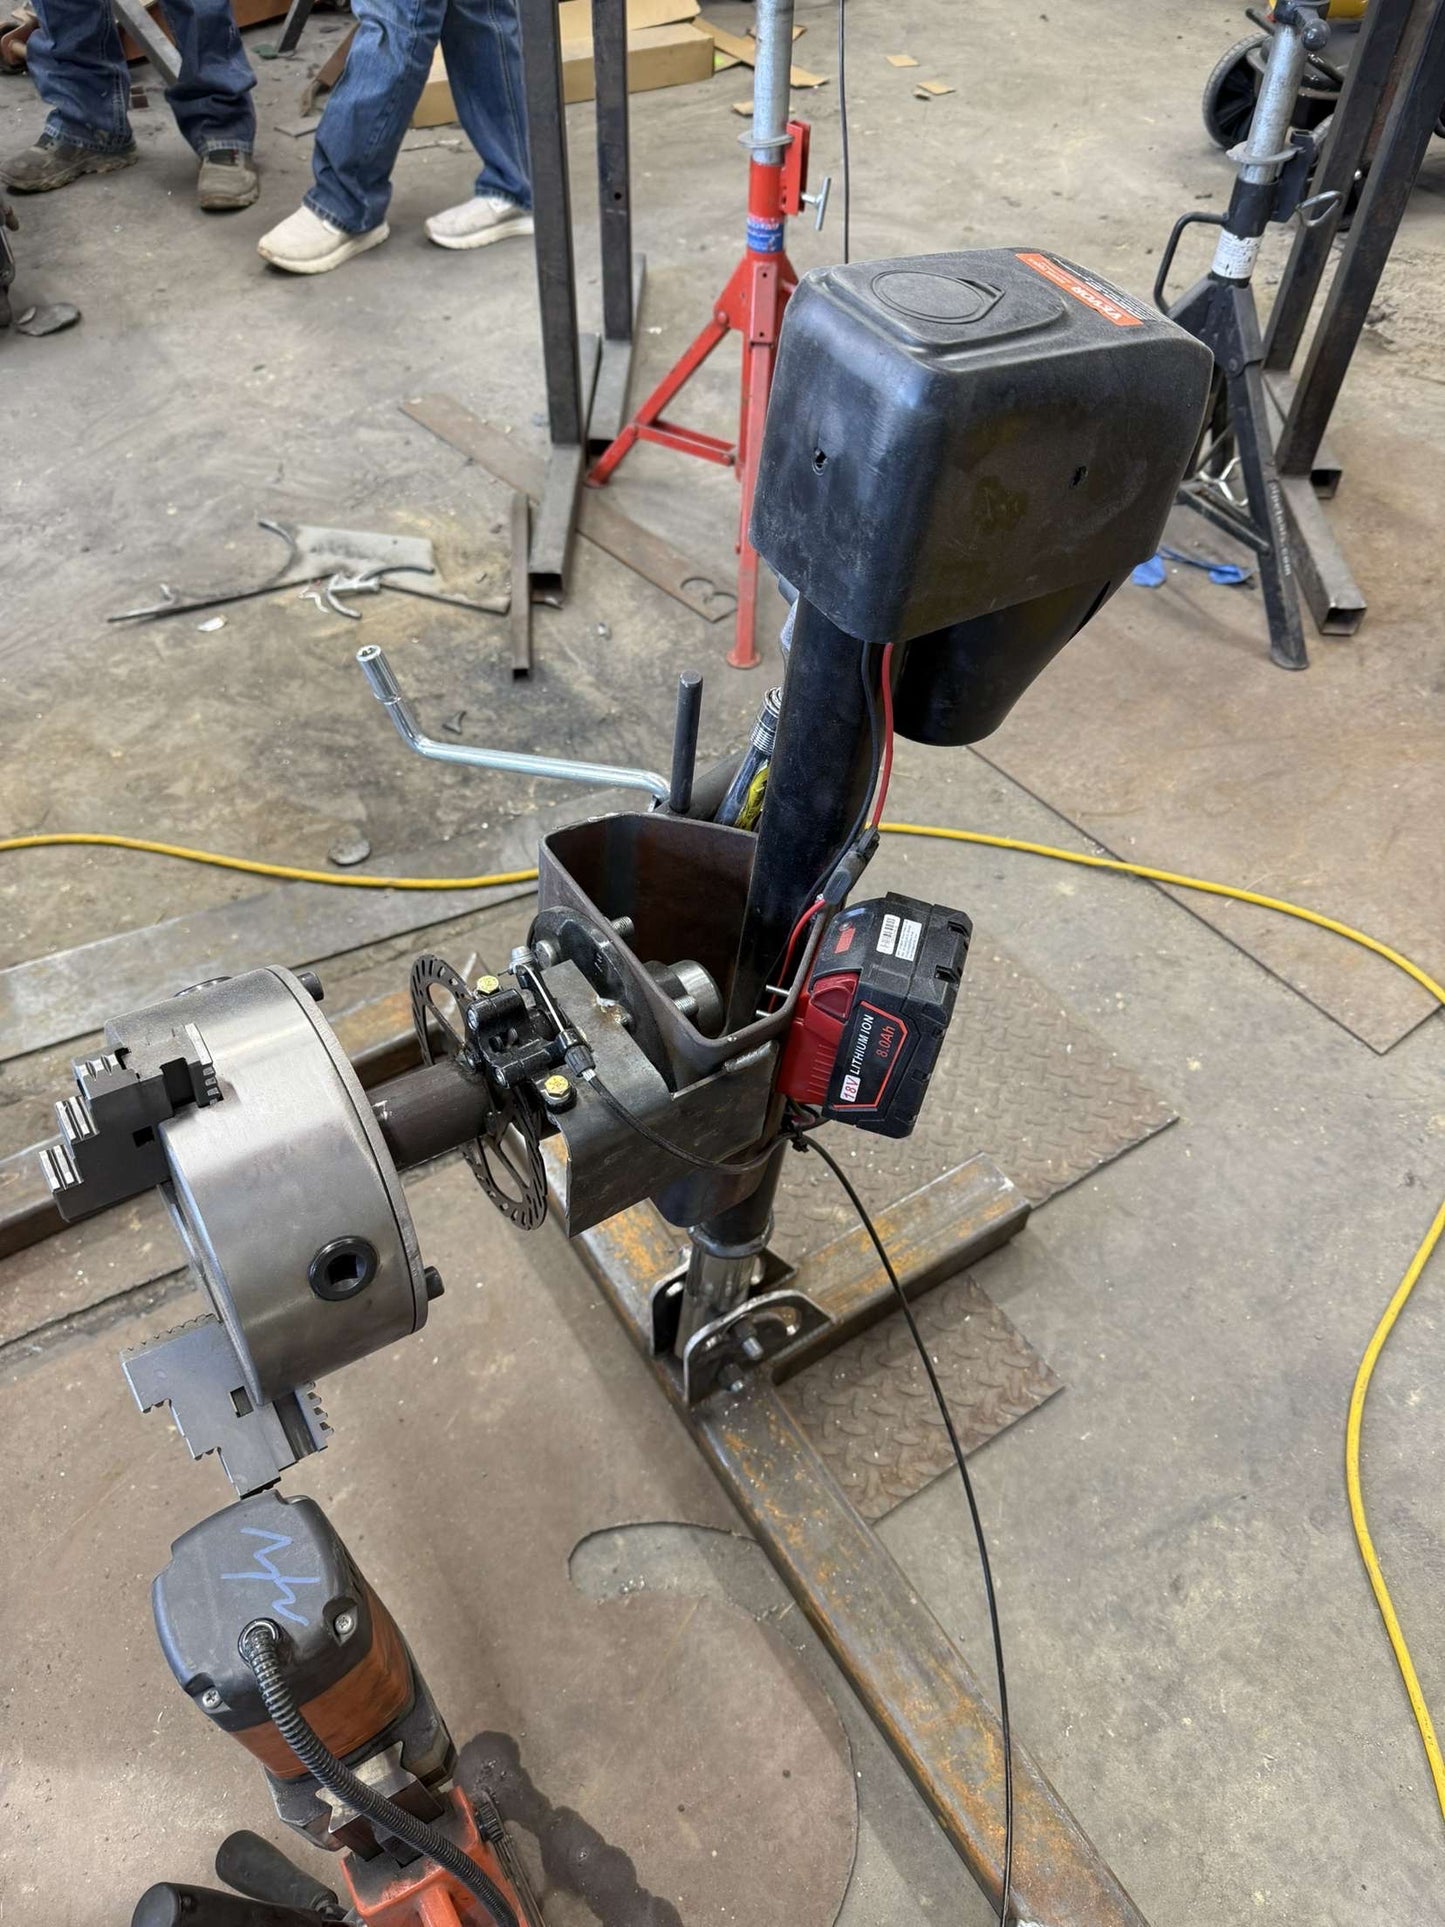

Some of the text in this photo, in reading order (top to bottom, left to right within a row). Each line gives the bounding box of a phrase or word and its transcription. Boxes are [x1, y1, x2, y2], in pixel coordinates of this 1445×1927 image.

[1071, 286, 1122, 320] VEVOR
[842, 1013, 874, 1101] 18V LITHIUM ION
[876, 1025, 896, 1058] 8.0Ah
